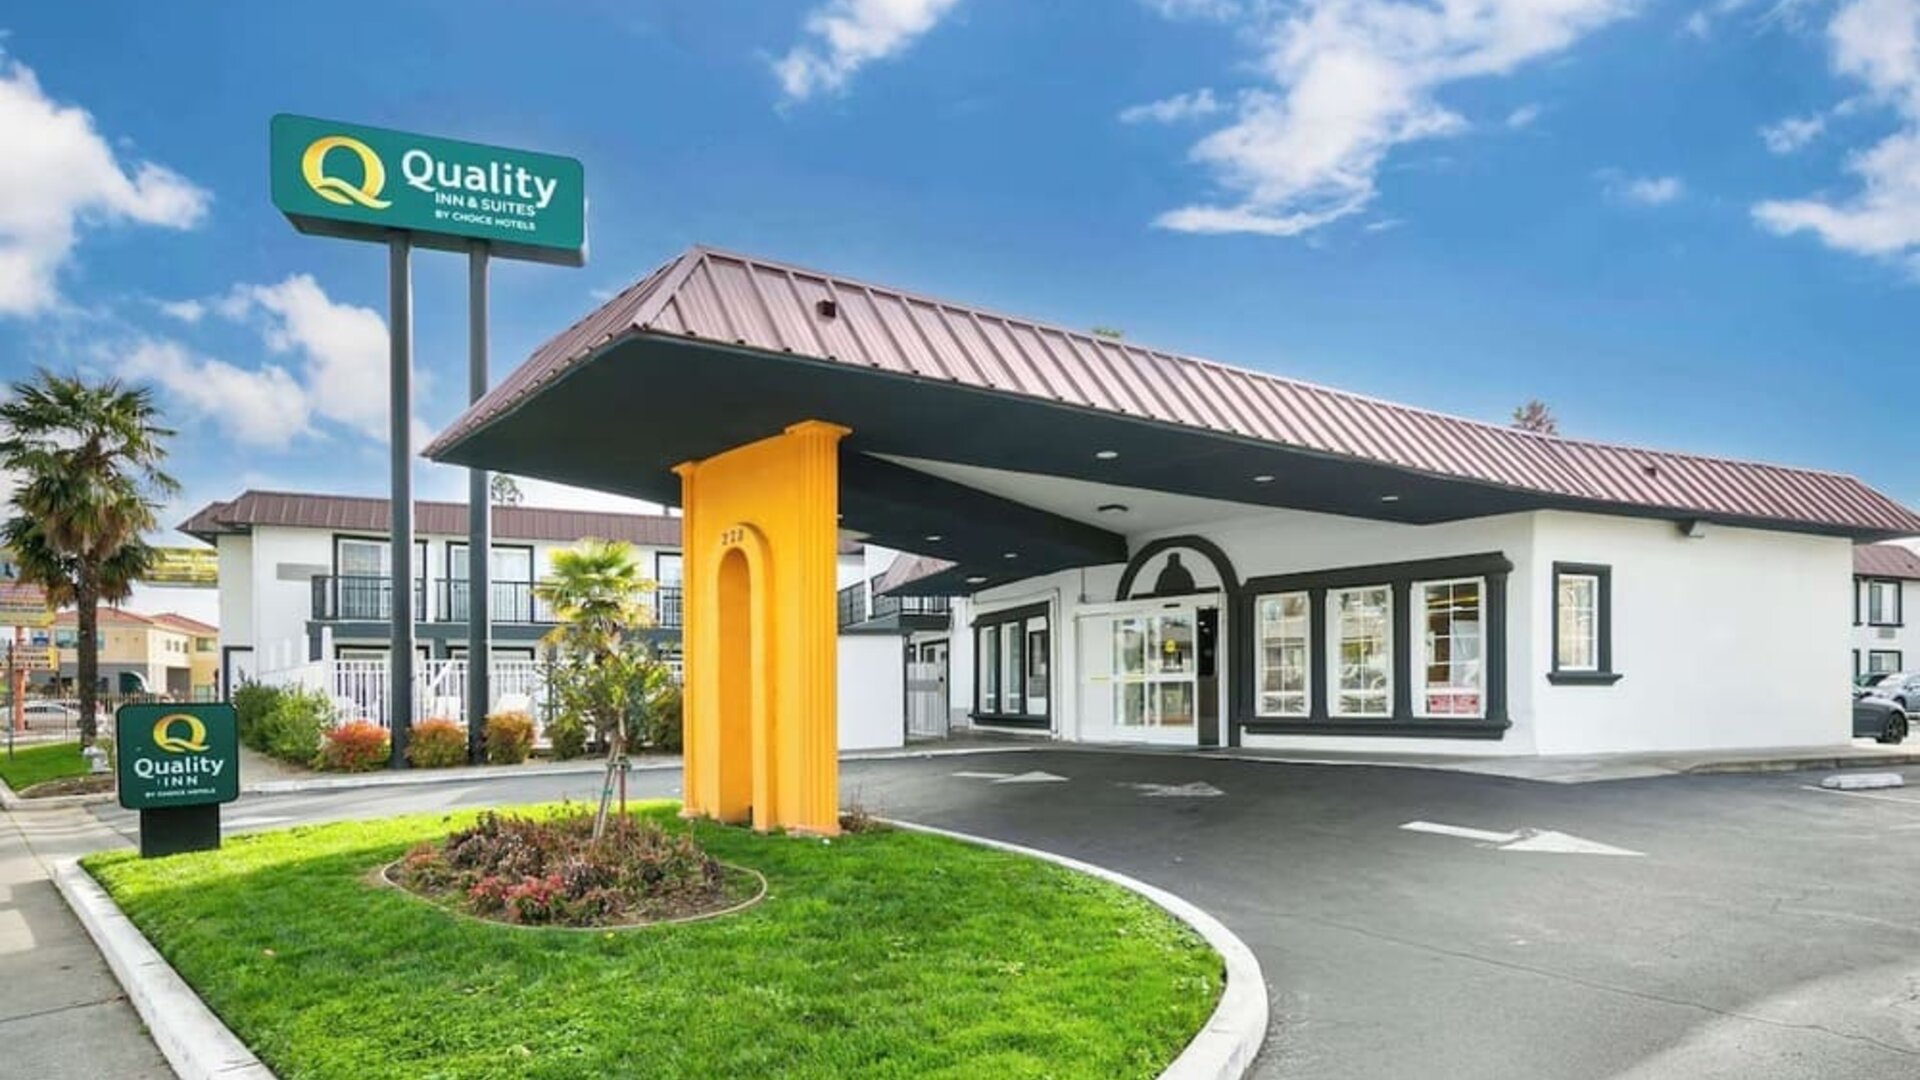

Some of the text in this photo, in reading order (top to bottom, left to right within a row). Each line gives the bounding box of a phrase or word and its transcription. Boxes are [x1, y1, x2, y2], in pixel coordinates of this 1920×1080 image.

[401, 149, 557, 209] Quality
[435, 192, 536, 218] INN & SUITES
[435, 210, 536, 231] BY CHOICE HOTELS
[134, 756, 224, 779] Quality
[164, 776, 198, 787] INN
